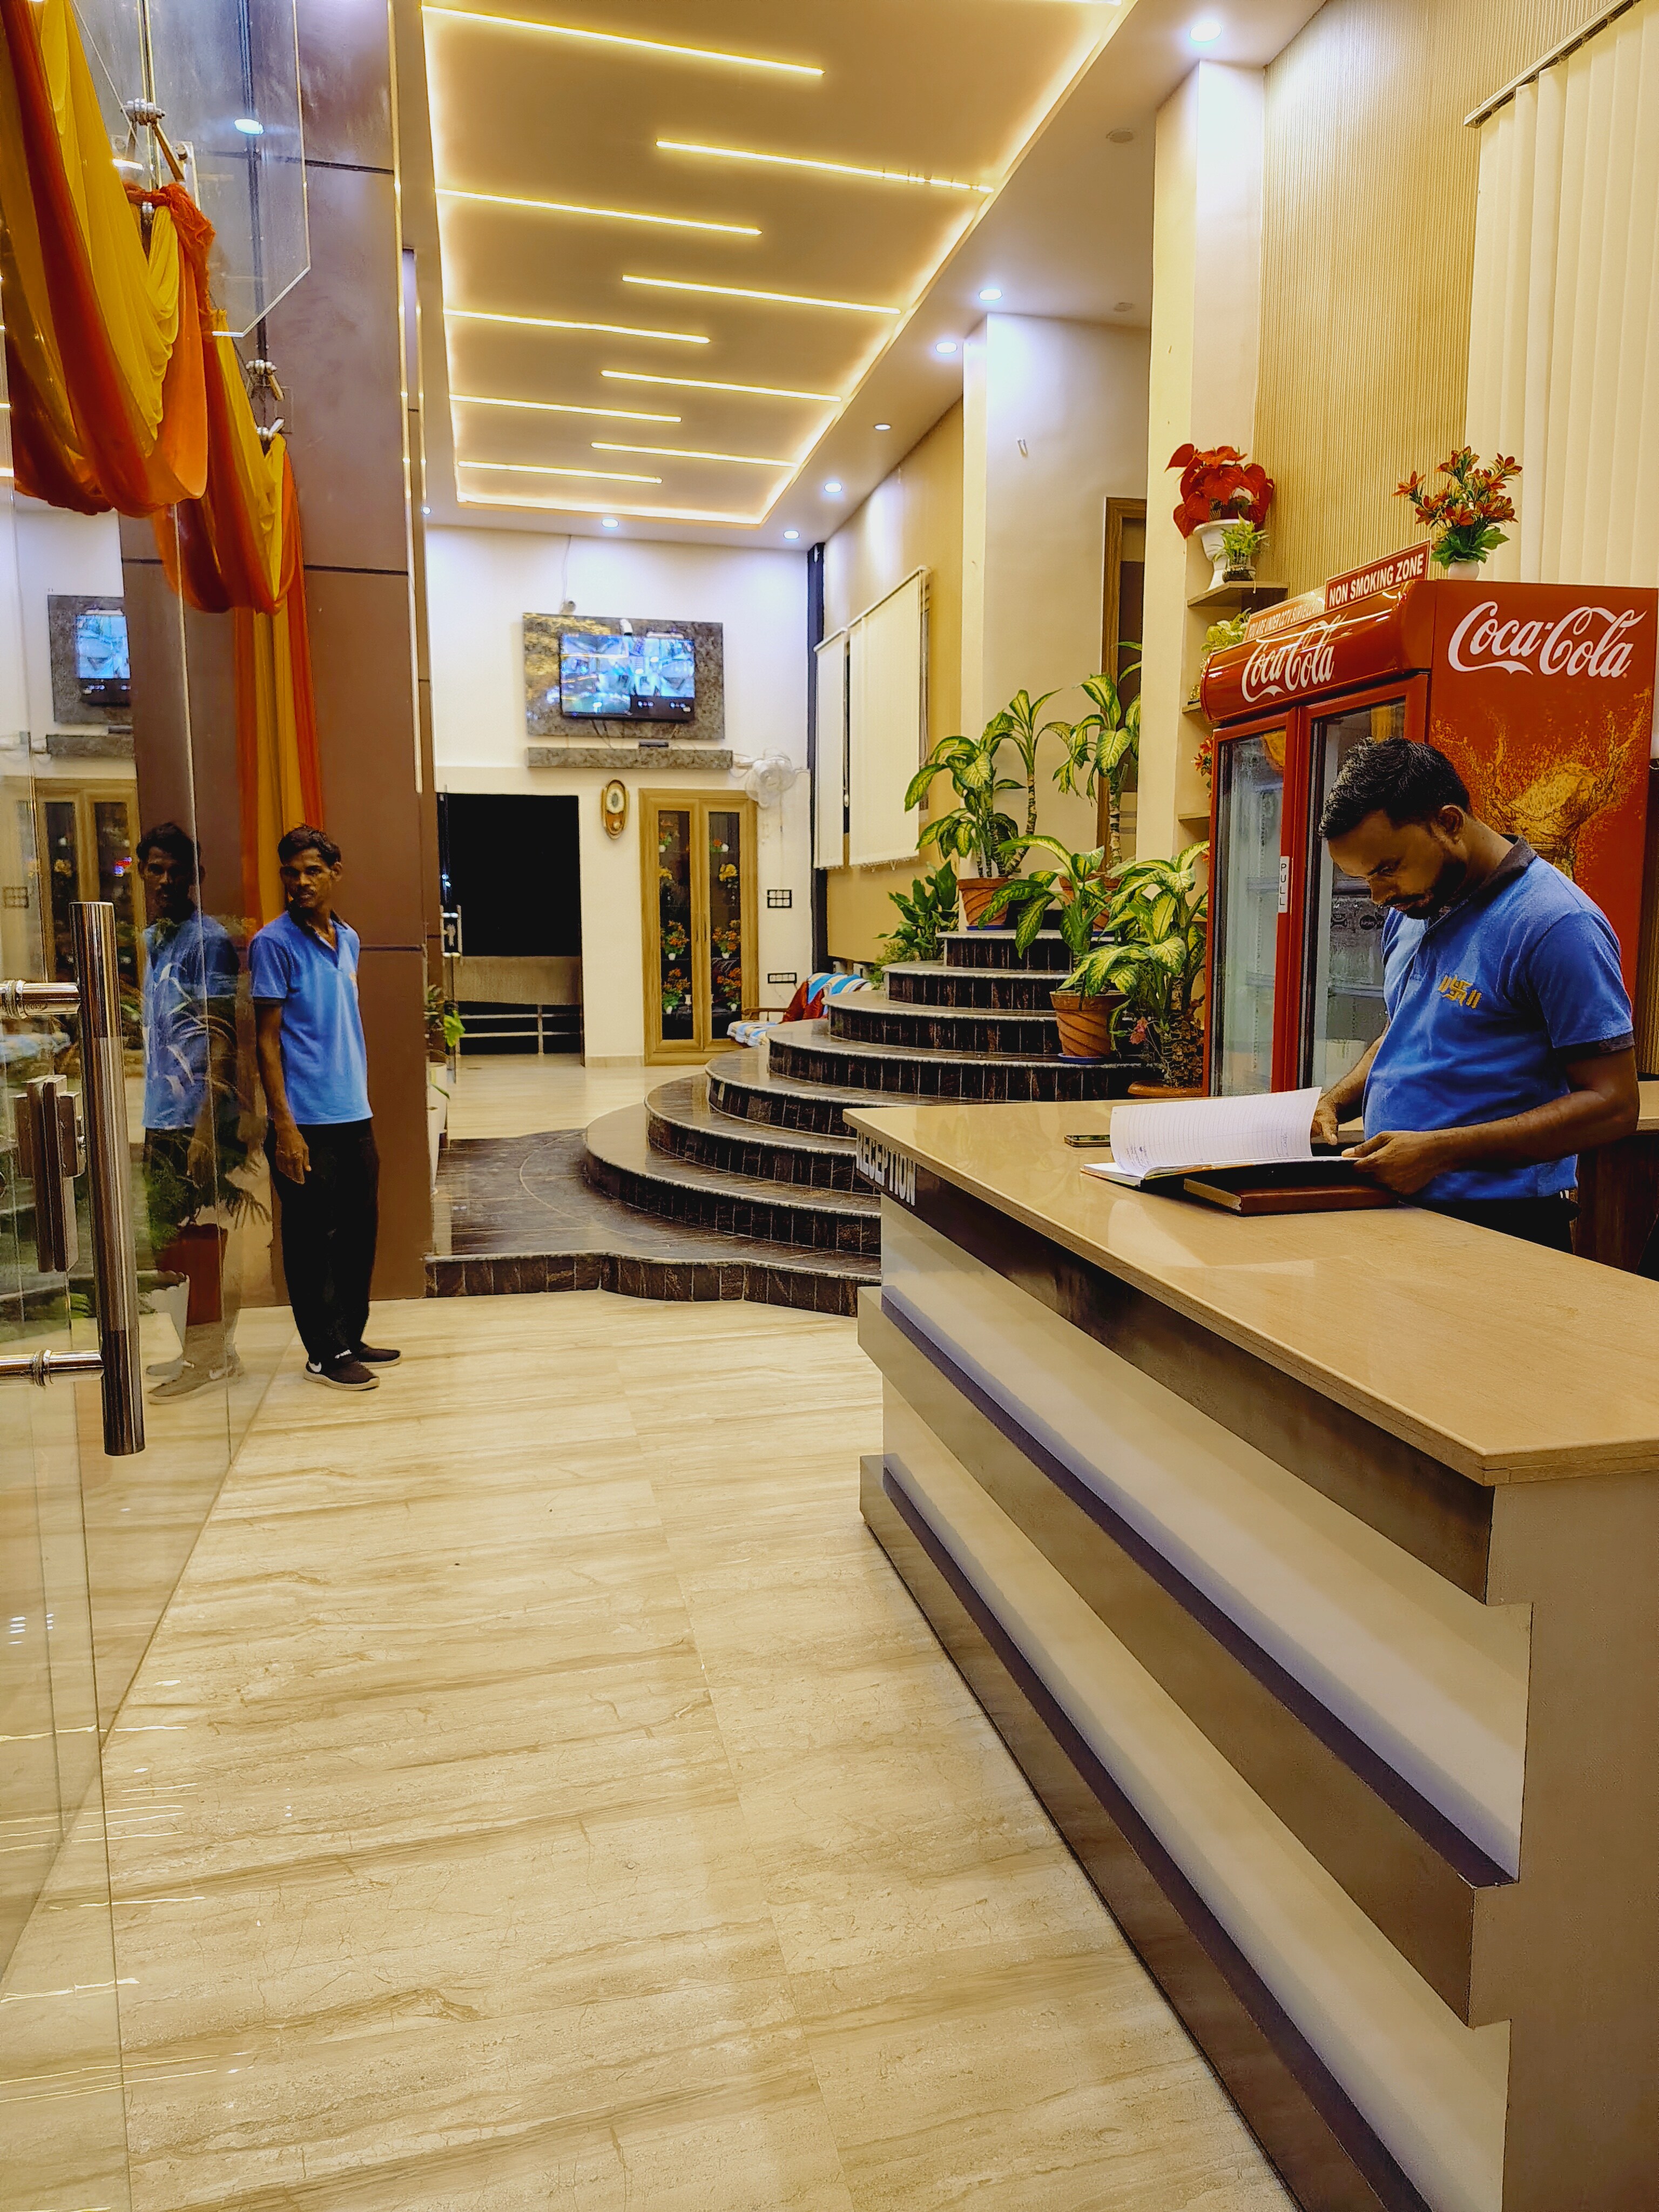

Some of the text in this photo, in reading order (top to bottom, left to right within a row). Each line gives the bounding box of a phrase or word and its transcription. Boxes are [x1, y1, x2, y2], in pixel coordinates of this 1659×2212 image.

[1329, 553, 1424, 608] NON SMOKING ZONE
[1448, 601, 1648, 678] Coca-Cola
[856, 1129, 916, 1206] RECEPTION
